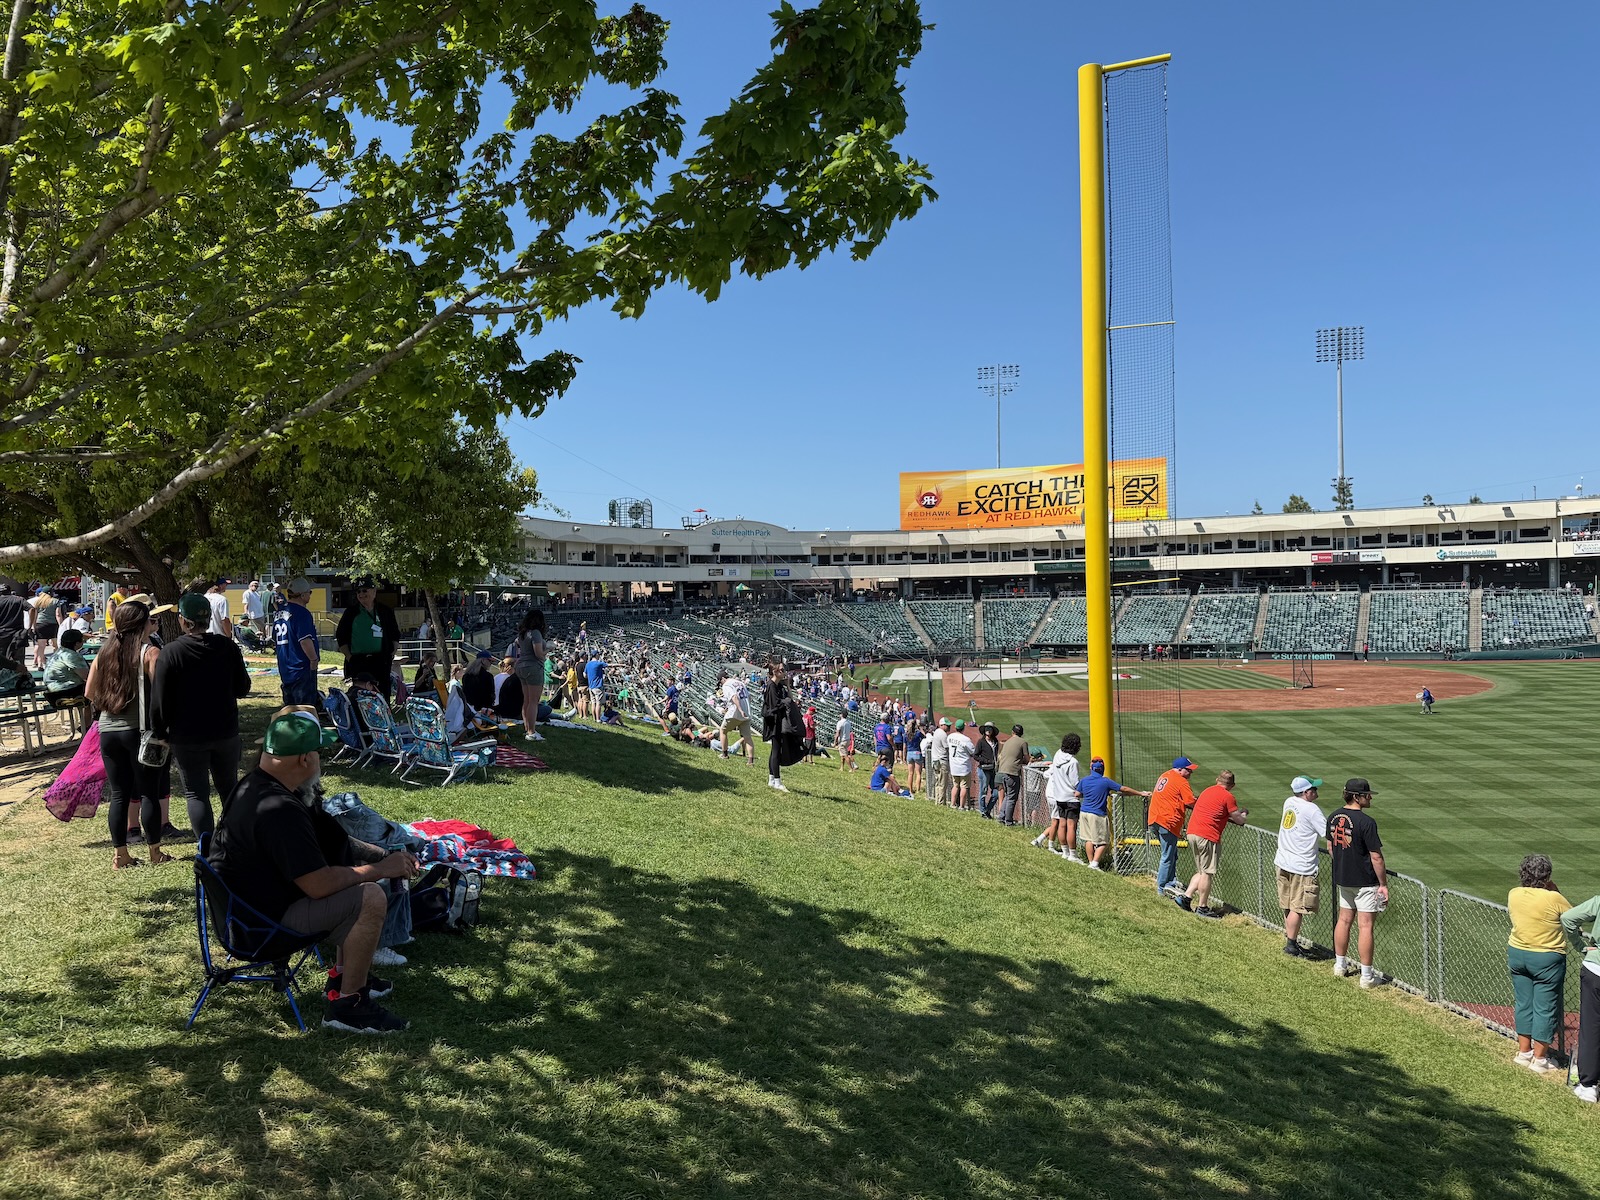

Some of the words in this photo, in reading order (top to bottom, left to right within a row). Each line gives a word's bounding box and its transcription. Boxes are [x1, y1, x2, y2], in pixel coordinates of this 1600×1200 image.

[974, 479, 1043, 499] CATCH
[957, 486, 1115, 517] EXCITEME
[985, 513, 1002, 523] AT
[1004, 511, 1031, 522] RED
[1034, 505, 1077, 519] HAWK!
[711, 528, 732, 536] Sutter
[732, 529, 755, 537] Health
[755, 529, 771, 537] Park
[1448, 550, 1471, 558] Sutter
[1471, 549, 1497, 558] Health
[274, 622, 289, 646] 22
[951, 745, 957, 758] 7
